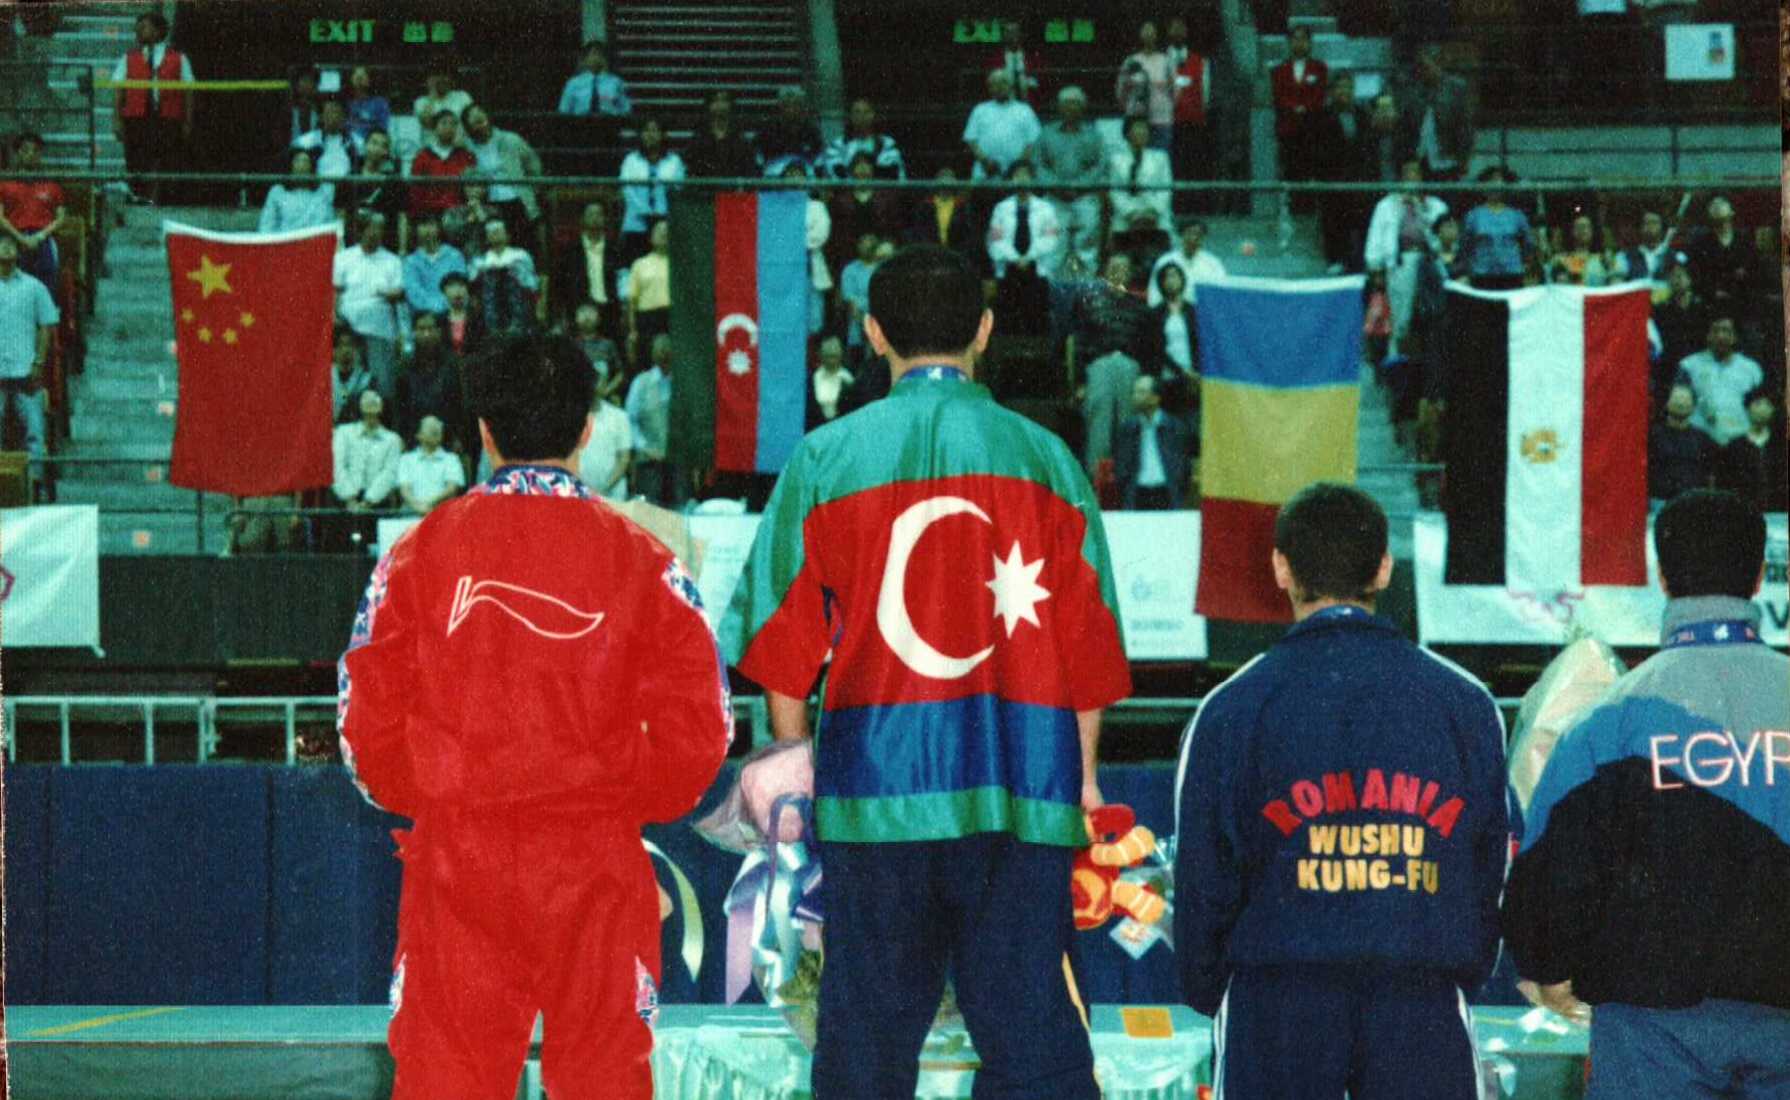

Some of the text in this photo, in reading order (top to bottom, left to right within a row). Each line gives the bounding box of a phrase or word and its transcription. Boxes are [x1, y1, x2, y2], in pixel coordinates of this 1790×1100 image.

[309, 19, 376, 42] EXIT
[952, 19, 1003, 43] EXI
[1262, 768, 1466, 838] ROMANIA
[1309, 824, 1425, 856] WUSHU
[1297, 859, 1440, 895] KUNG-FU
